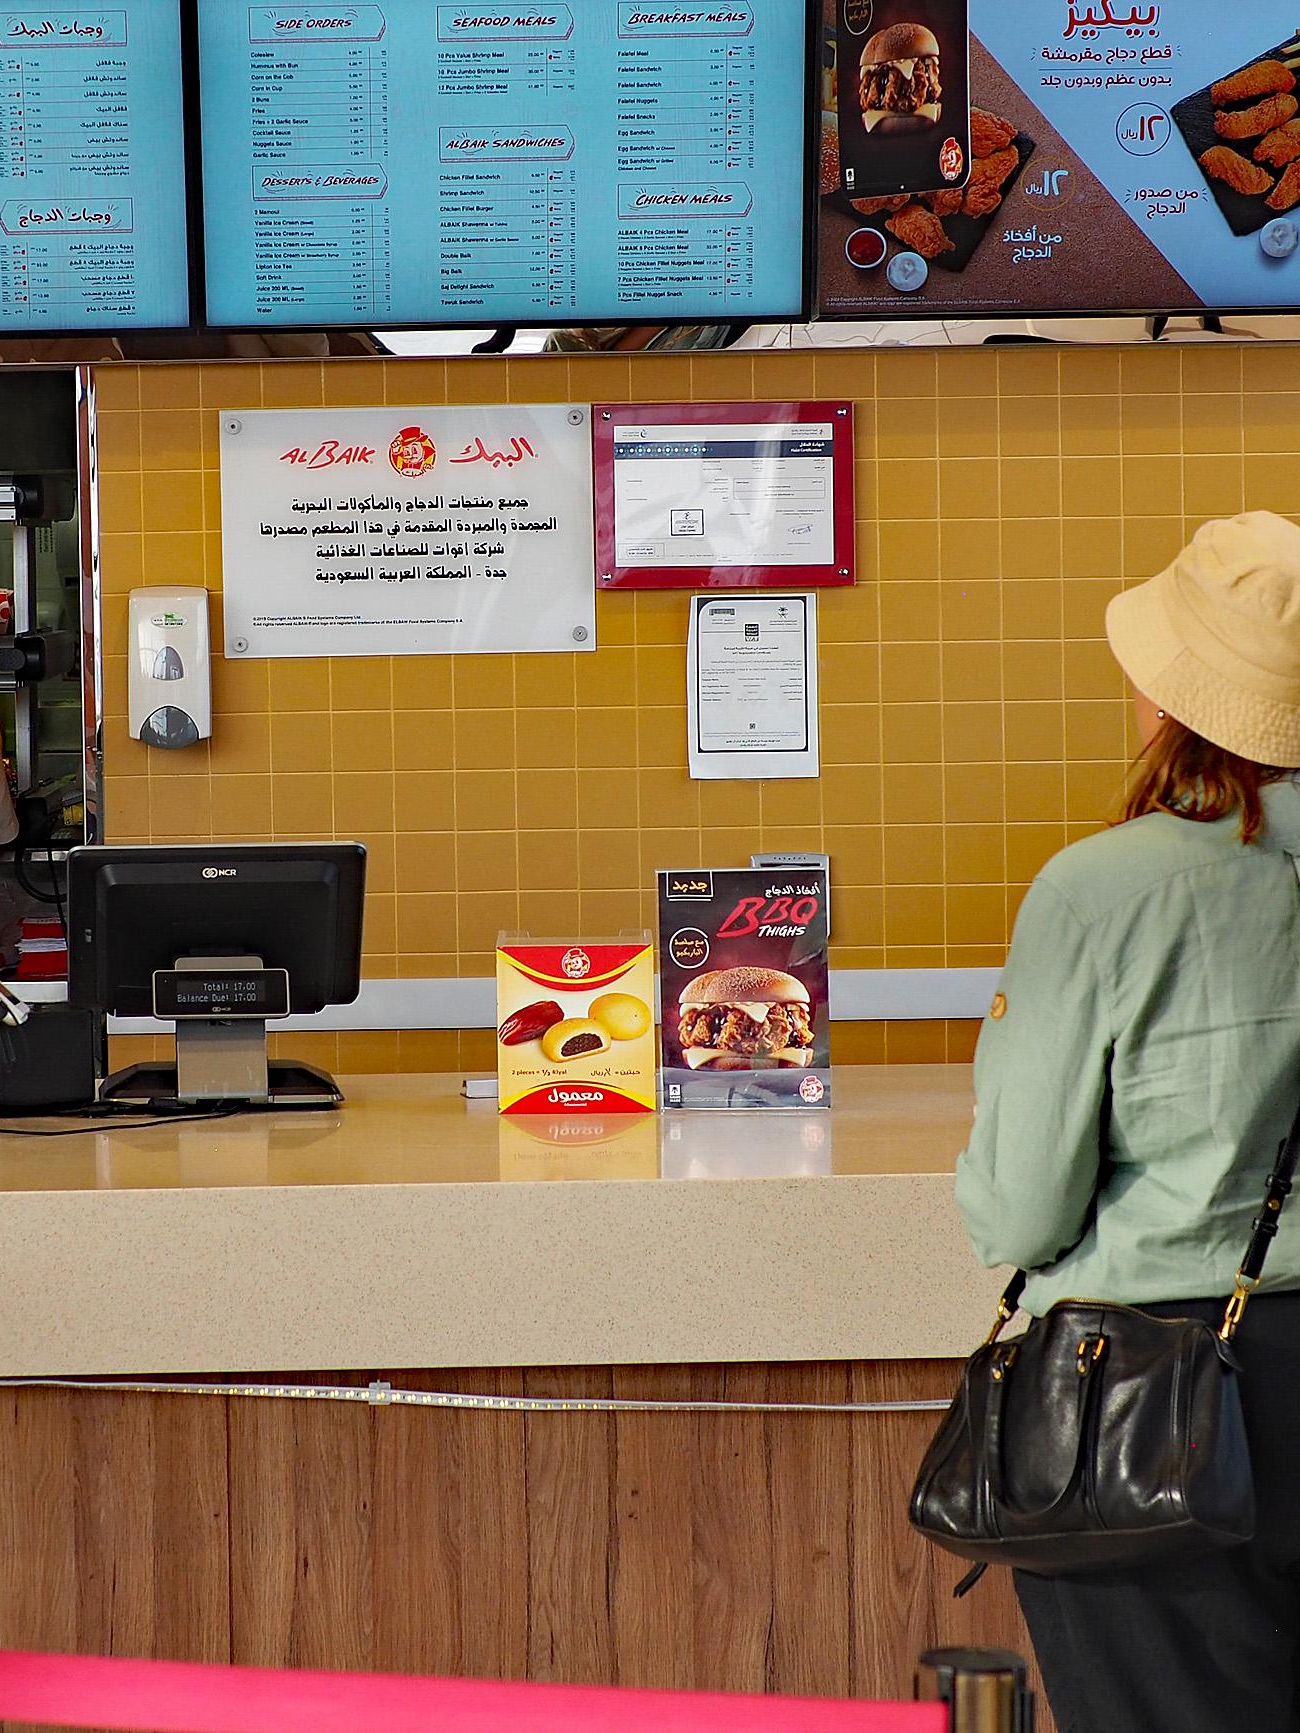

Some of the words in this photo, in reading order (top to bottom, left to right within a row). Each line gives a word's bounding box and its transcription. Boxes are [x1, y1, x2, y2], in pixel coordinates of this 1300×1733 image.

[275, 19, 303, 29] SIDE
[306, 18, 352, 28] ORDERS
[453, 16, 510, 27] SEAFOOD
[513, 16, 557, 26] MEALS
[628, 13, 704, 24] BREAKFAST
[705, 12, 747, 23] MEALS
[1063, 0, 1156, 37] بيكيز
[7, 21, 55, 38] البيك
[59, 21, 103, 38] وجبات
[1041, 48, 1102, 62] مقرمشة
[1105, 48, 1137, 65] دجاج
[1140, 45, 1172, 65] قطع
[1041, 75, 1061, 88] جلد
[1065, 76, 1102, 88] وبدون
[1105, 74, 1136, 89] عظم
[1138, 75, 1172, 87] بدون
[1121, 128, 1138, 140] ريال
[1139, 115, 1164, 141] ١٢
[446, 139, 490, 149] ALBAIK
[492, 138, 565, 148] SANDWICHES
[261, 177, 312, 187] DESSERTS
[322, 176, 380, 187] BEVERAGES
[1043, 170, 1069, 196] ١٢
[1025, 184, 1043, 195] ريال
[1134, 188, 1172, 201] صدور
[1175, 189, 1199, 200] من
[636, 194, 689, 206] CHICKEN
[690, 194, 733, 204] MEALS
[19, 209, 64, 227] الدجاج
[68, 208, 111, 225] وجبات
[1146, 202, 1186, 220] الدجاج
[1003, 225, 1037, 243] أفخاذ
[1039, 231, 1062, 243] من
[1012, 246, 1052, 263] الدجاج
[279, 440, 376, 469] ALBAIK
[450, 437, 534, 468] البيك
[291, 497, 332, 514] البحرية
[336, 494, 402, 513] والمأكولات
[405, 496, 444, 512] الدجاج
[448, 496, 494, 509] منتجات
[498, 497, 529, 510] جميع
[260, 522, 308, 539] مصدرها
[311, 520, 359, 537] المطعم
[364, 520, 383, 534] هذا
[387, 522, 401, 539] في
[404, 519, 451, 533] المقدمة
[456, 518, 507, 534] والمبردة
[511, 516, 557, 531] المجمدة
[316, 543, 366, 559] الغذائية
[370, 543, 429, 557] للصناعات
[433, 543, 469, 558] اقوات
[473, 541, 505, 557] شركة
[315, 567, 374, 584] السعودية
[378, 567, 421, 582] العربية
[425, 565, 472, 579] المملكة
[483, 565, 507, 581] جدة
[673, 881, 708, 894] جديد
[765, 884, 794, 898] الدجاج
[794, 882, 821, 896] أفخاذ
[716, 896, 819, 939] BBQ
[757, 925, 806, 938] THIGHS
[203, 983, 229, 991] Total:
[234, 982, 256, 991] 17.00
[177, 994, 209, 1003] Balance
[212, 993, 229, 1002] Due:
[234, 993, 256, 1002] 17.00
[548, 1089, 603, 1103] معمول
